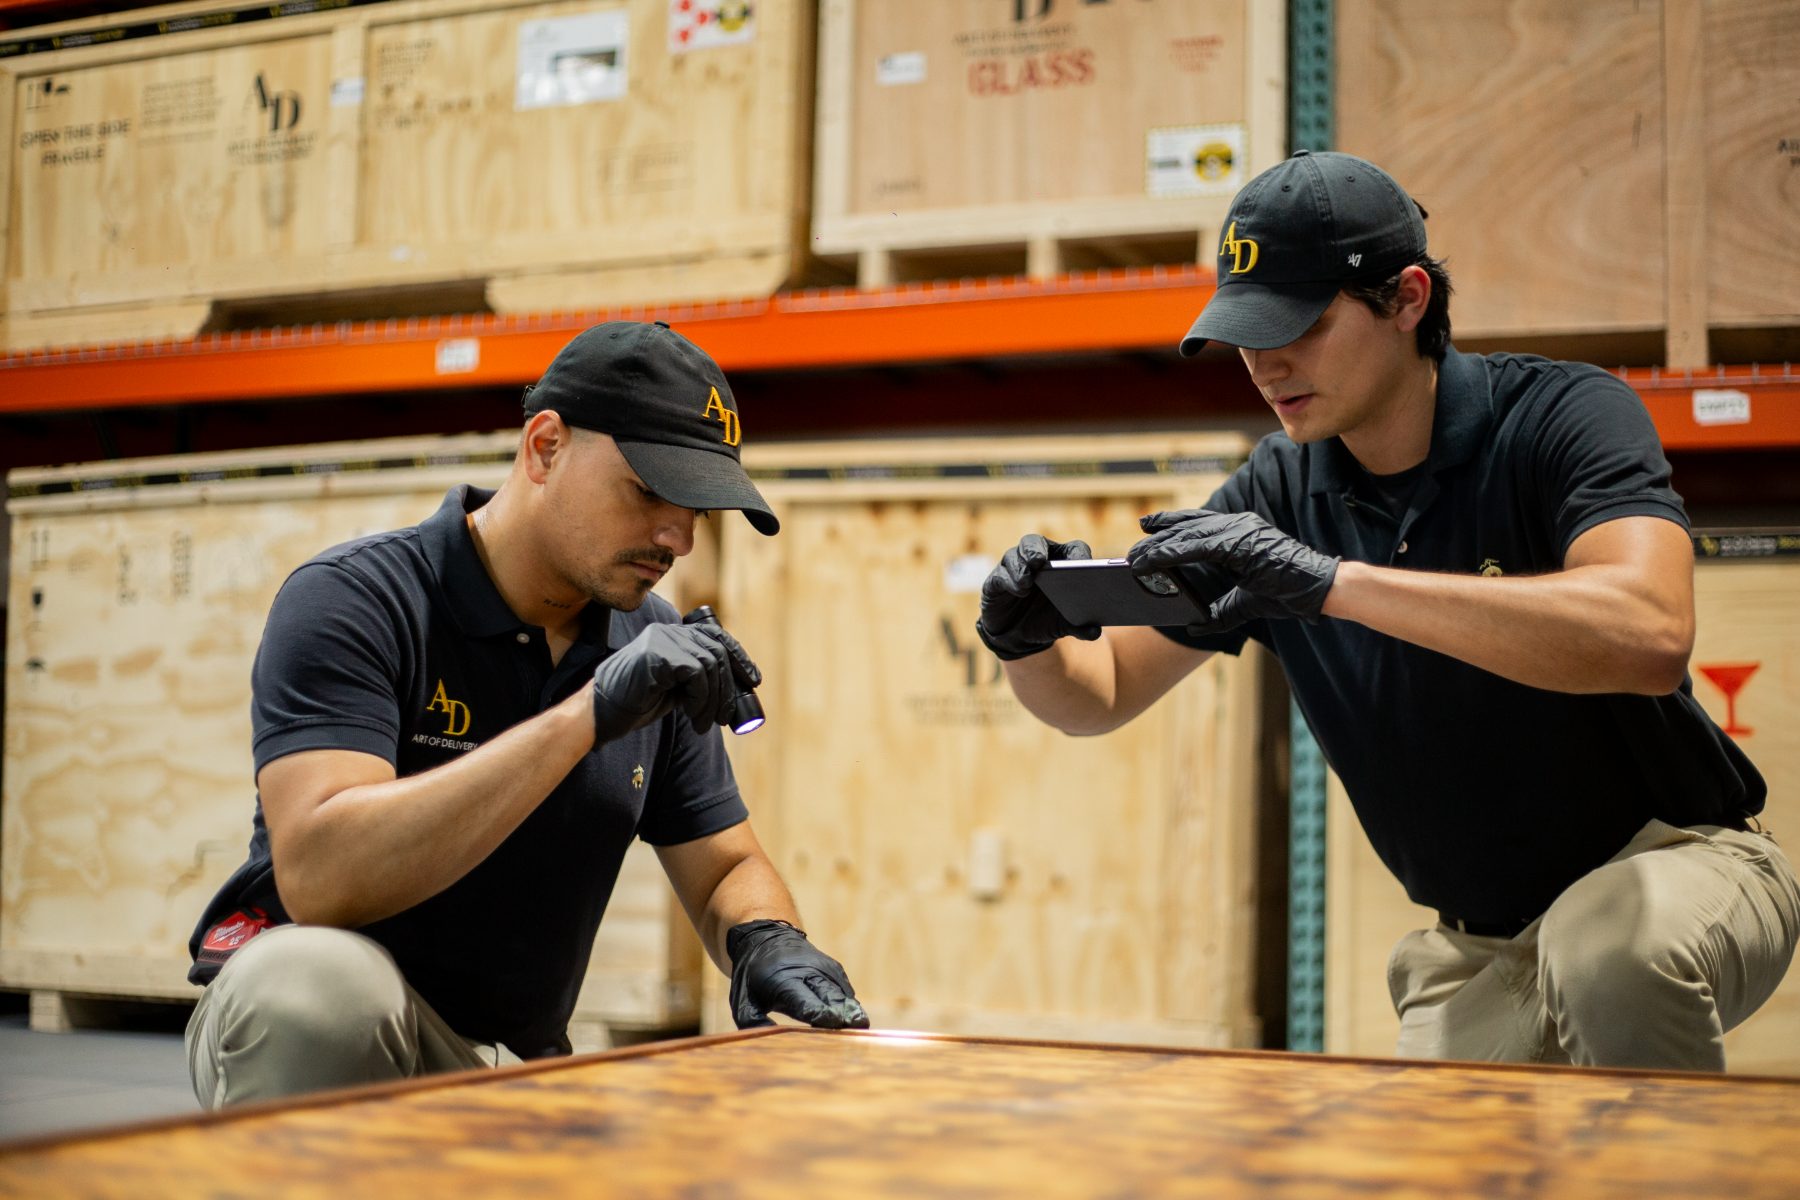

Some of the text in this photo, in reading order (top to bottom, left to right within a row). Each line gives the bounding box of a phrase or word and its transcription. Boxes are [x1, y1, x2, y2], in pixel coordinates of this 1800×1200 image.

[967, 49, 1096, 97] GLASS
[1219, 221, 1259, 274] AD
[702, 386, 741, 447] AD
[426, 678, 471, 736] AD
[411, 734, 478, 751] ART OF DELIVERY
